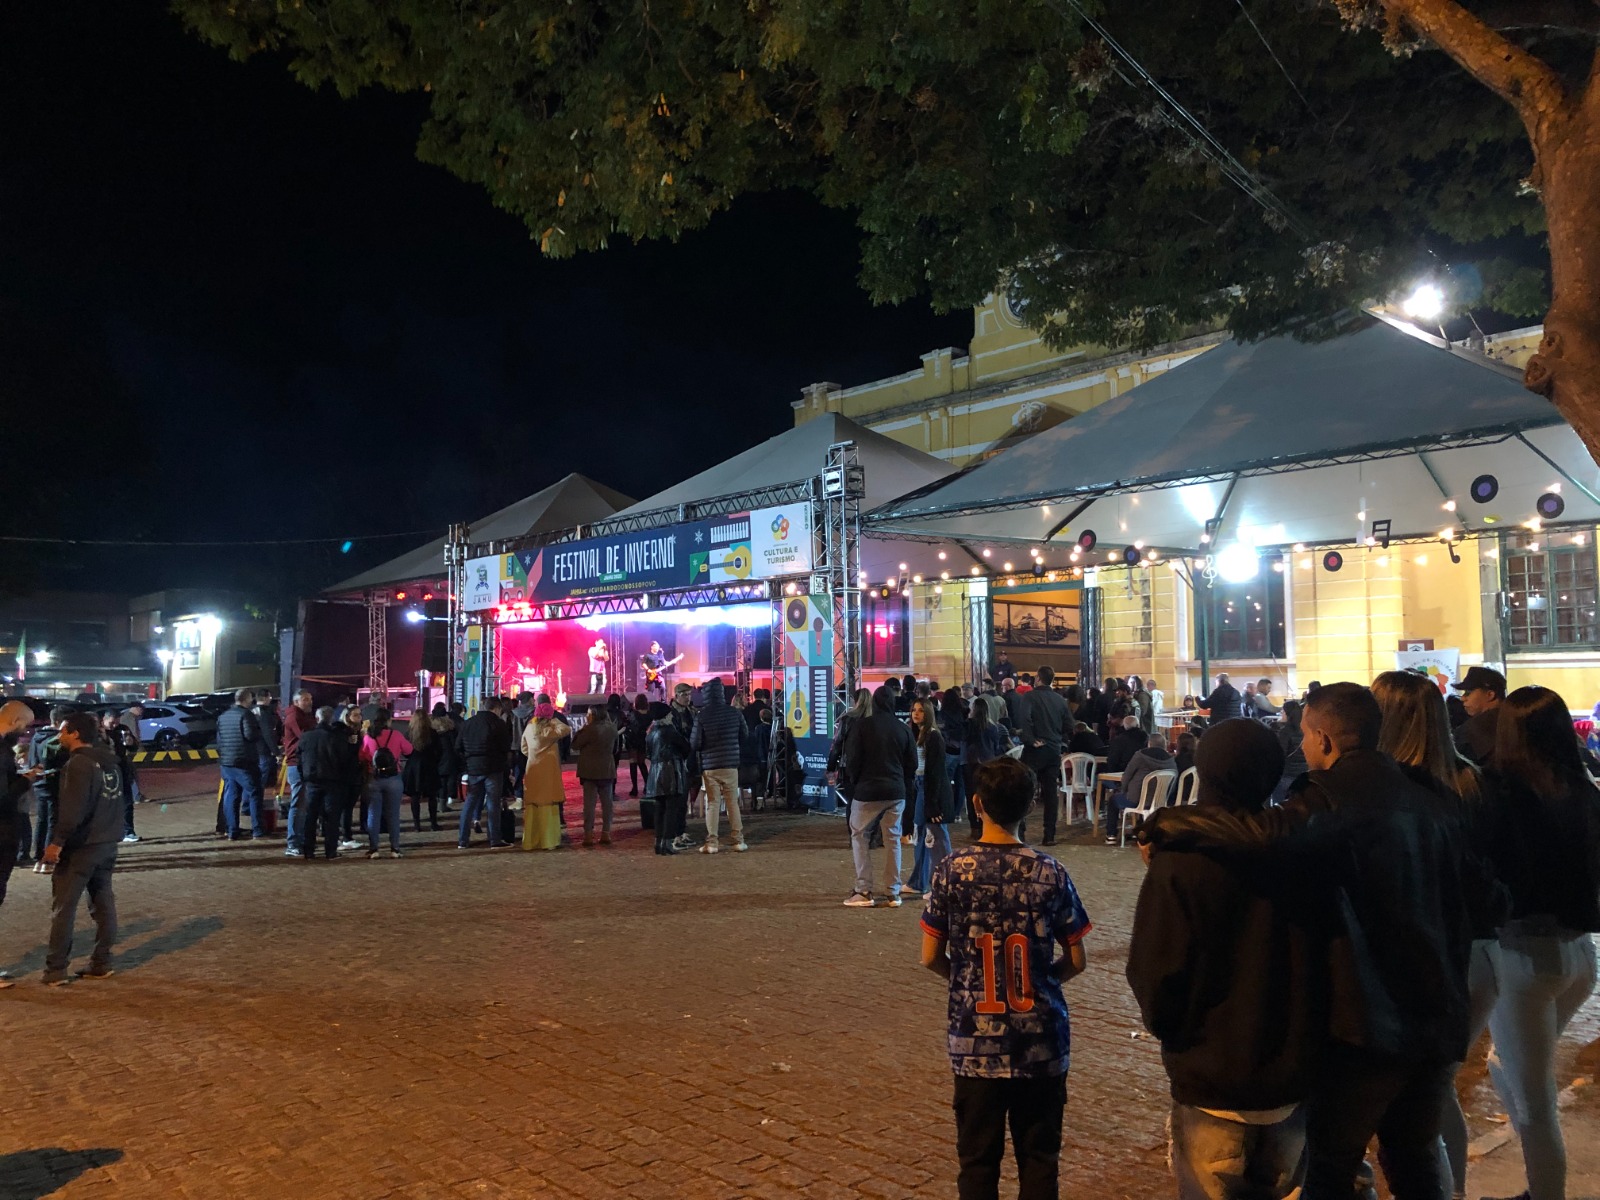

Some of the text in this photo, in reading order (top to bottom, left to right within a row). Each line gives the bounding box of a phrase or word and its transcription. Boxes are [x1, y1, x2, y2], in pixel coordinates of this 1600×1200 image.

[764, 547, 793, 556] CULTURA
[554, 536, 674, 583] FESTIVAL DE INVERNO
[767, 555, 795, 564] TURISMO
[473, 596, 491, 604] JAHU
[975, 932, 1034, 1014] 10
